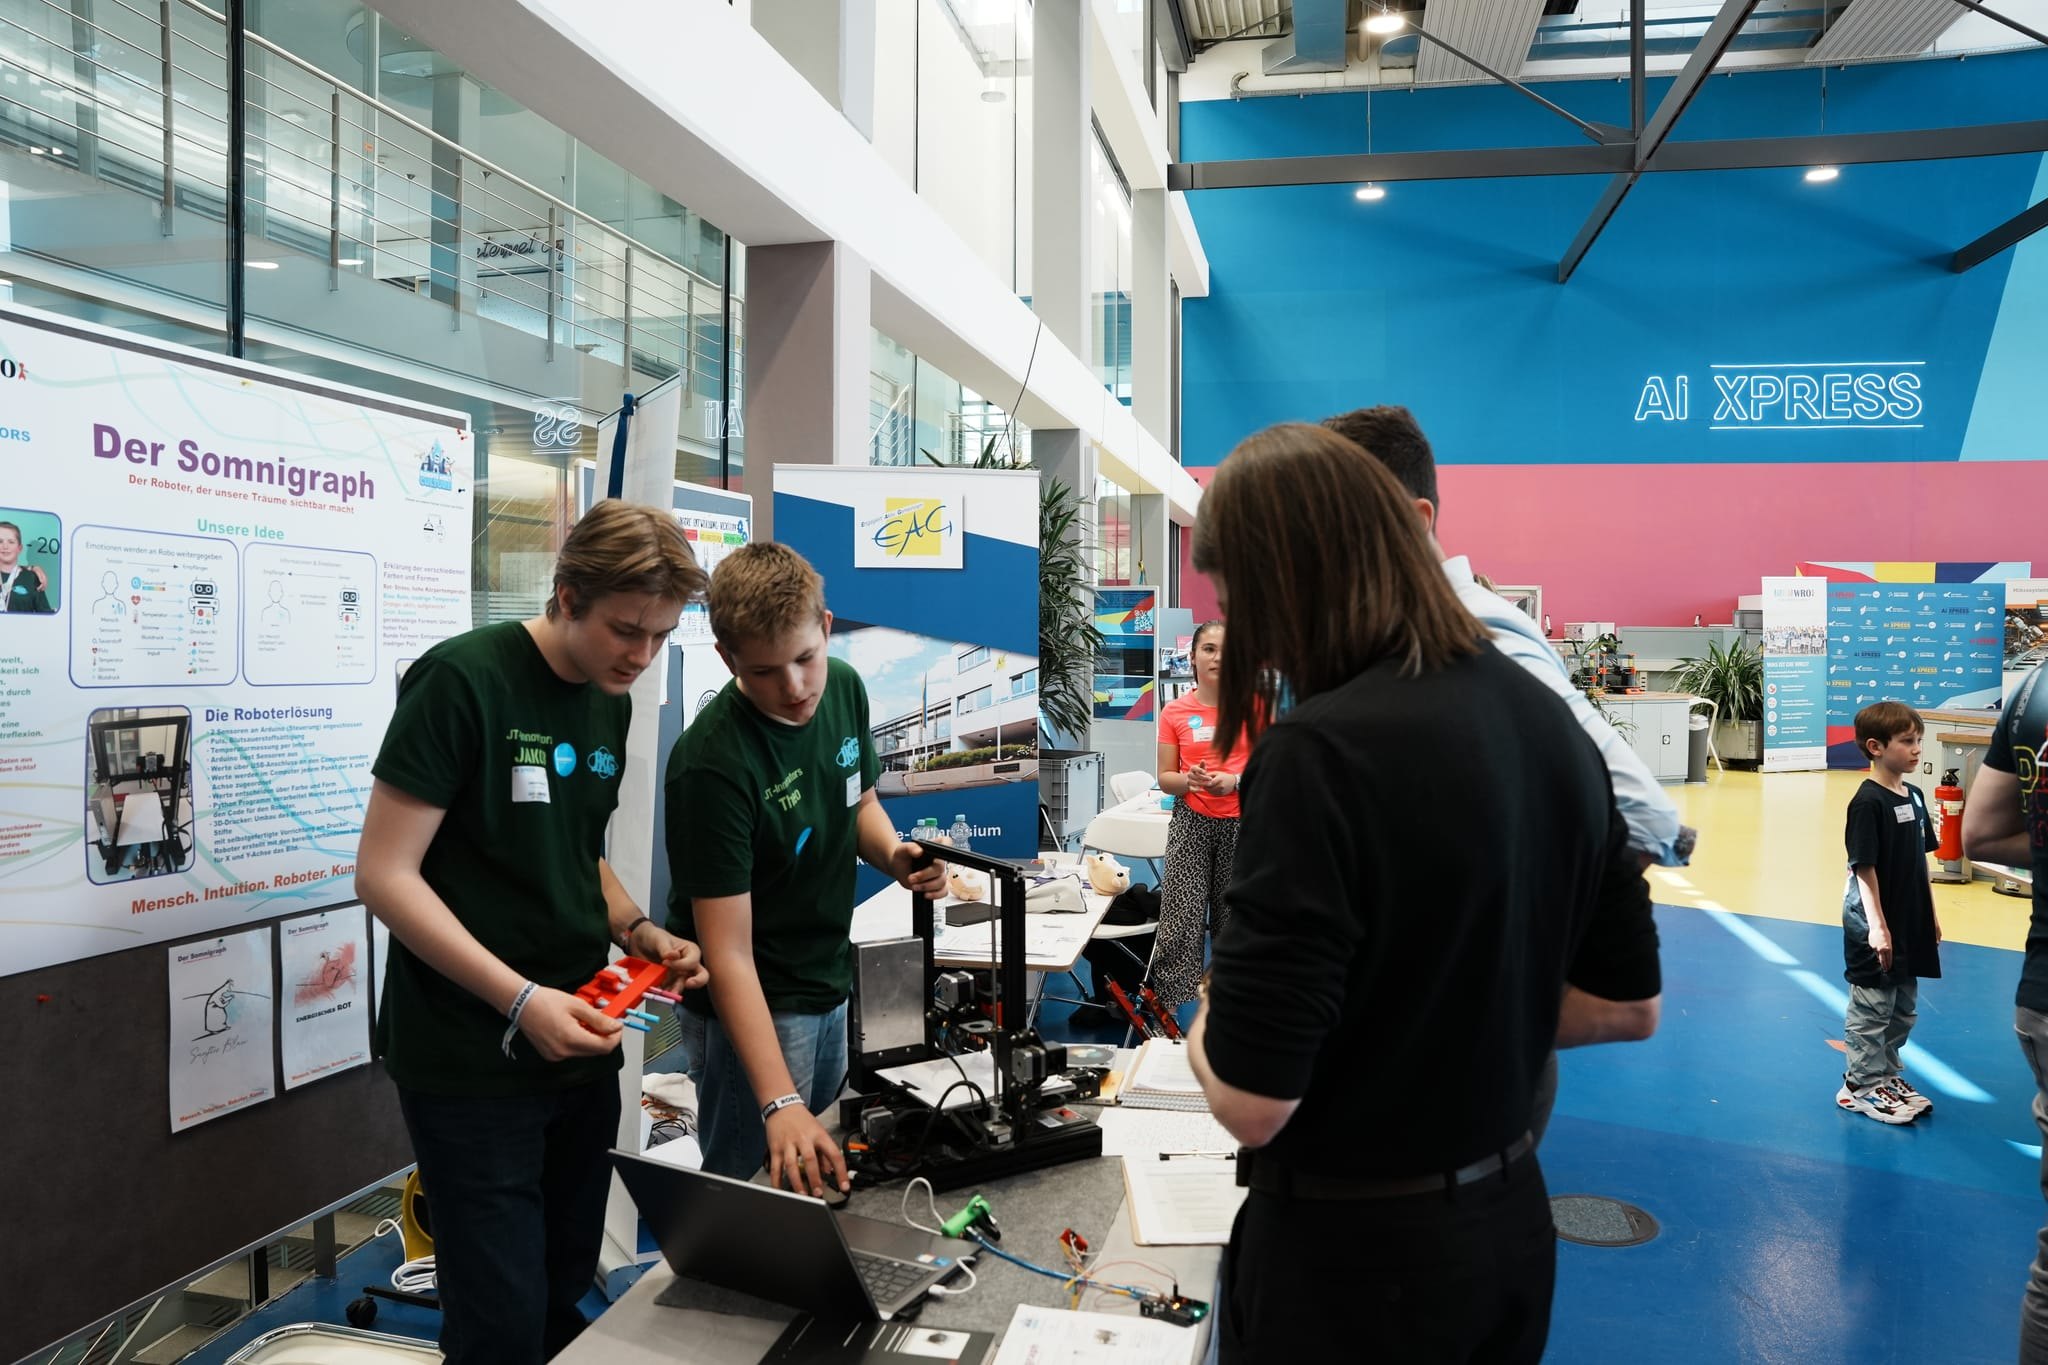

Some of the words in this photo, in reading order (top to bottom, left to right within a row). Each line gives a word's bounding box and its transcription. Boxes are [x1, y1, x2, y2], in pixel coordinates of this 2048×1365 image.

[1634, 376, 1688, 420] AI
[1713, 373, 1922, 420] XPRESS
[93, 423, 166, 466] Der
[177, 439, 375, 502] Somnigraph
[129, 474, 147, 486] Der
[151, 477, 193, 494] Roboter,
[196, 485, 212, 496] der
[215, 488, 249, 501] unsere
[290, 498, 327, 511] sichtbar
[328, 504, 355, 514] macht
[196, 518, 249, 536] Unsere
[254, 524, 285, 540] Idee
[86, 542, 122, 552] Emotionen
[123, 546, 148, 555] werden
[205, 709, 229, 722] Die
[234, 706, 333, 721] Roboterlösung
[213, 802, 237, 810] Python
[238, 798, 271, 806] Programm
[214, 846, 241, 854] Roboter
[131, 891, 200, 915] Mensch.
[203, 881, 270, 902] Intuition.
[274, 870, 327, 889] Roboter.
[332, 864, 358, 876] Kun
[298, 922, 328, 933] Somnigraph
[178, 954, 189, 962] Der
[190, 946, 227, 960] Somnigraph
[337, 1001, 352, 1011] ROT
